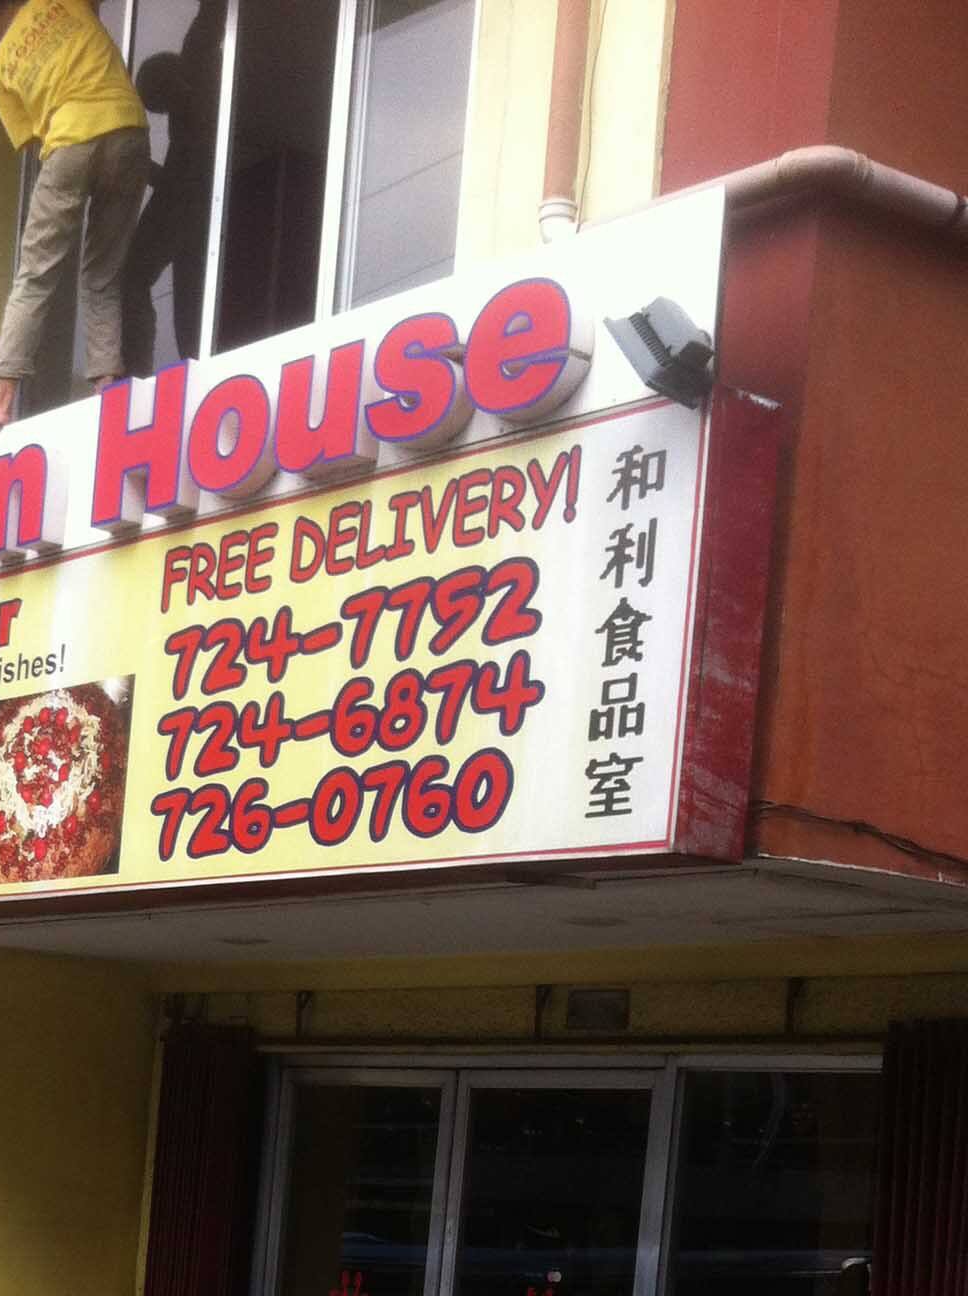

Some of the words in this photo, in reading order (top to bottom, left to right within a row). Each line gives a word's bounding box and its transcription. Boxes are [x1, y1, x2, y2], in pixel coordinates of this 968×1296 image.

[91, 277, 573, 527] House
[160, 521, 279, 613] FREE
[290, 444, 582, 583] DELIVERY!
[165, 556, 544, 701] 724-7752
[584, 443, 667, 820] 和利食品室
[157, 656, 546, 782] 724-6874
[151, 747, 515, 862] 726-0760
